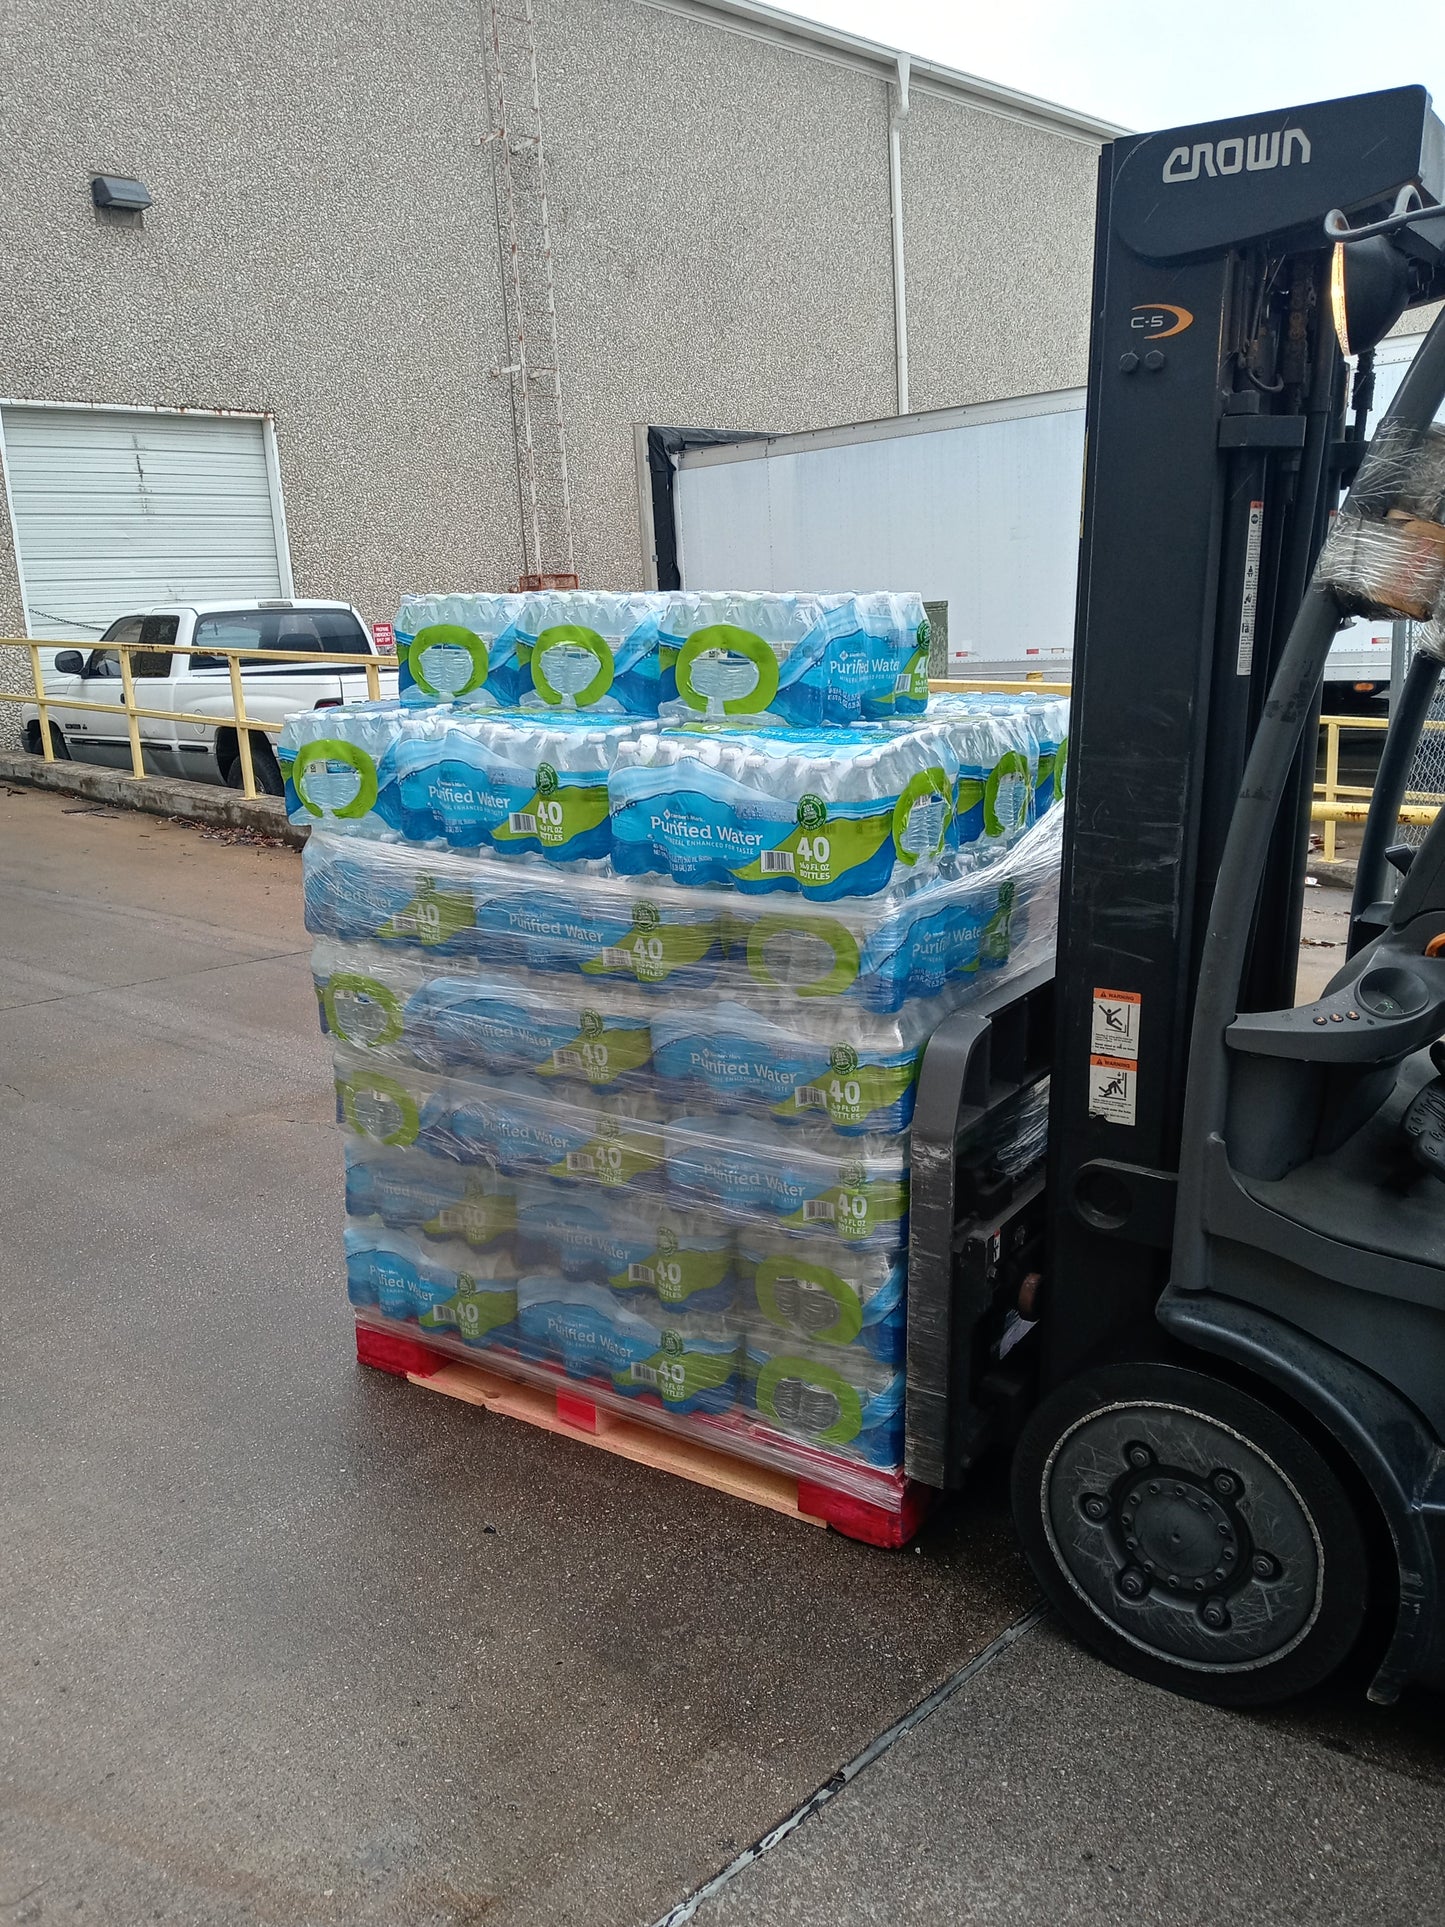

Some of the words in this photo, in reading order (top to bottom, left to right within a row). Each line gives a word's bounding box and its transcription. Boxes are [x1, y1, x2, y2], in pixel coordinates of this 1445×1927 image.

[1162, 128, 1312, 184] CROWN
[1130, 315, 1164, 329] C-5
[477, 791, 511, 809] Water
[537, 801, 563, 826] 40
[650, 815, 713, 840] Purified
[716, 825, 763, 846] Water
[796, 836, 830, 863] 40
[820, 863, 830, 871] OZ
[509, 912, 562, 935] Purified
[564, 923, 603, 943] Water
[633, 937, 663, 962] 40
[690, 1052, 750, 1075] Purified
[753, 1063, 798, 1085] Water
[829, 1079, 861, 1105] 40
[534, 1126, 569, 1148] Water
[596, 1146, 622, 1170] 40
[703, 1164, 760, 1185] Purified
[765, 1174, 806, 1197] Water
[837, 1193, 868, 1220] 40
[656, 1260, 682, 1285] 40
[547, 1318, 596, 1344] Purified
[600, 1335, 634, 1359] Water
[658, 1360, 685, 1385] 40
